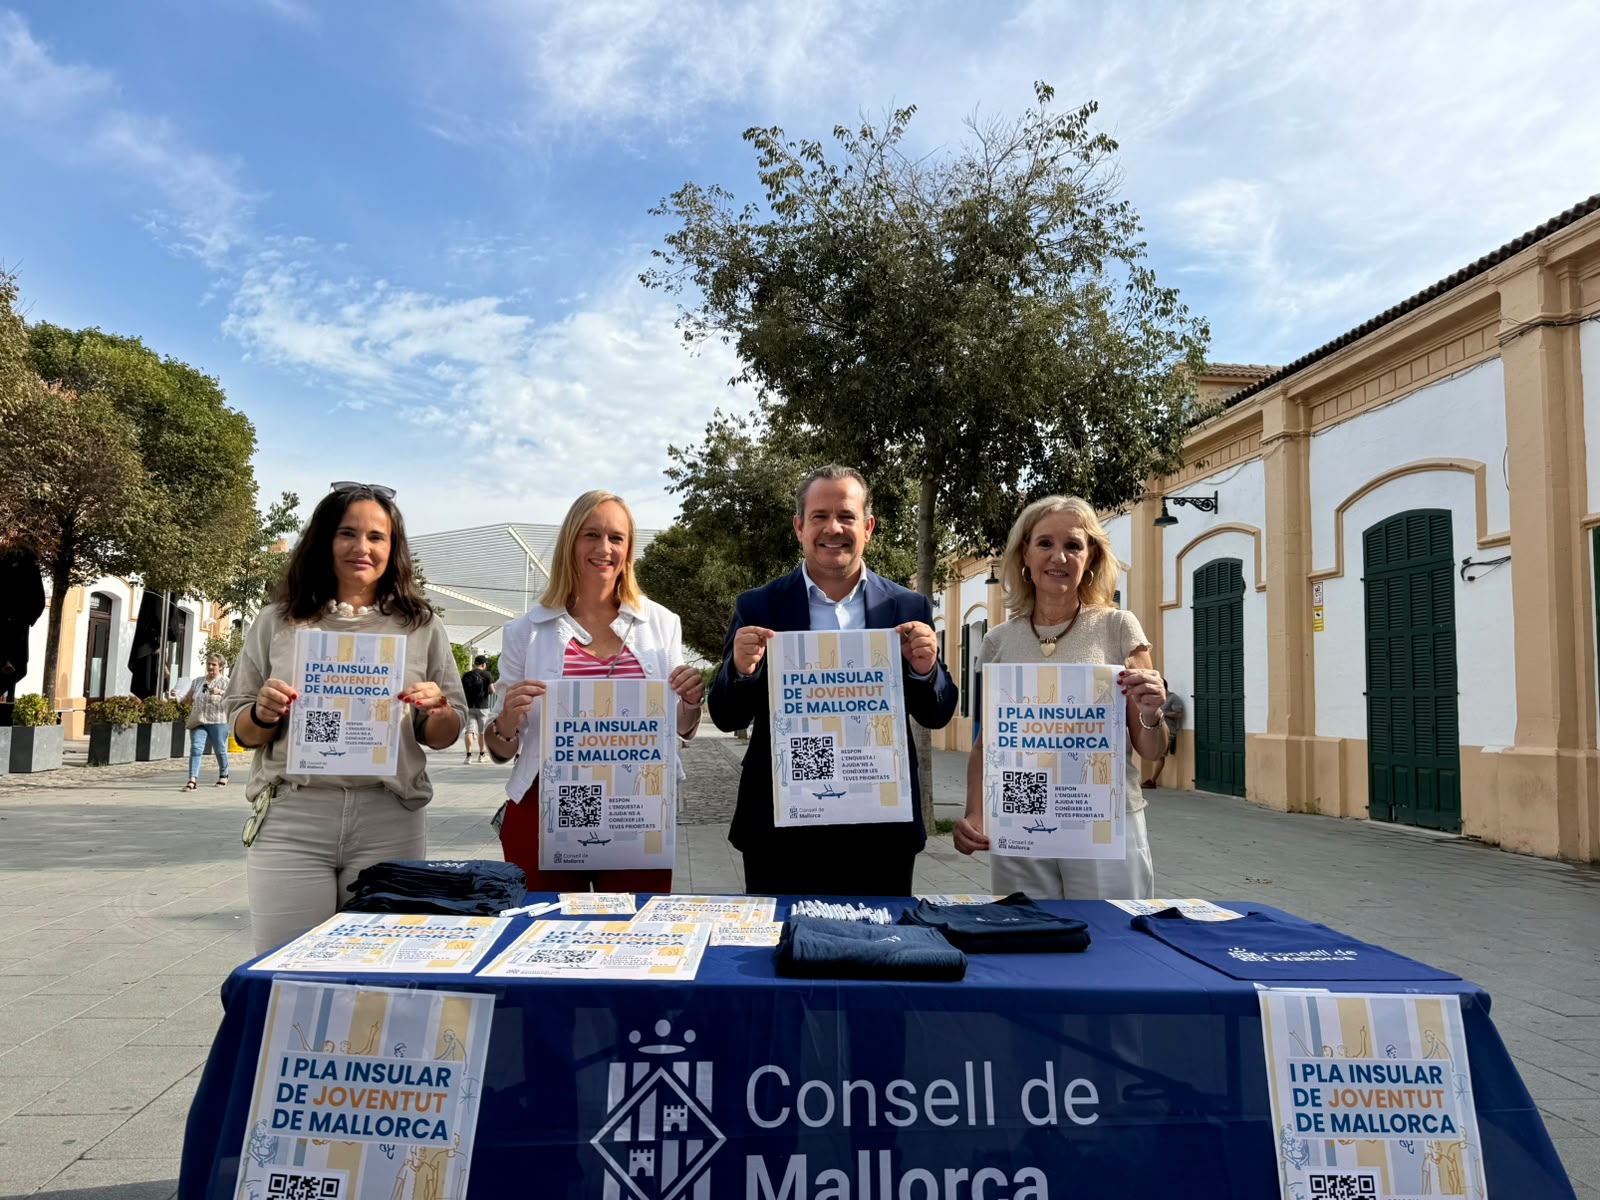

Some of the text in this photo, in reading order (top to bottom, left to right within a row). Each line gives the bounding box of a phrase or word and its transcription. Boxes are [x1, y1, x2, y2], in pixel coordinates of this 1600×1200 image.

[306, 663, 389, 675] I PLA INSULAR
[305, 674, 388, 686] DE JOVENTUT
[783, 671, 884, 685] I PLA INSULAR
[304, 685, 390, 696] DE MALLORCA
[784, 685, 884, 700] DE JOVENTUT
[784, 699, 890, 714] DE MALLORCA
[998, 707, 1105, 719] I PLA INSULAR
[555, 720, 658, 733] I PLA INSULAR
[998, 721, 1105, 735] DE JOVENTUT
[555, 734, 658, 747] DE JOVENTUT
[998, 736, 1109, 749] DE MALLORCA
[555, 749, 661, 762] DE MALLORCA
[280, 1057, 452, 1088] I PLA INSULAR
[1289, 1063, 1443, 1085] I PLA INSULAR
[276, 1082, 448, 1114] DE JOVENTUT
[746, 1060, 1100, 1129] Consell de
[1292, 1088, 1444, 1109] DE JOVENTUT
[271, 1108, 449, 1141] DE MALLORCA
[1295, 1112, 1456, 1134] DE MALLORCA
[745, 1149, 1048, 1200] Mallorca
